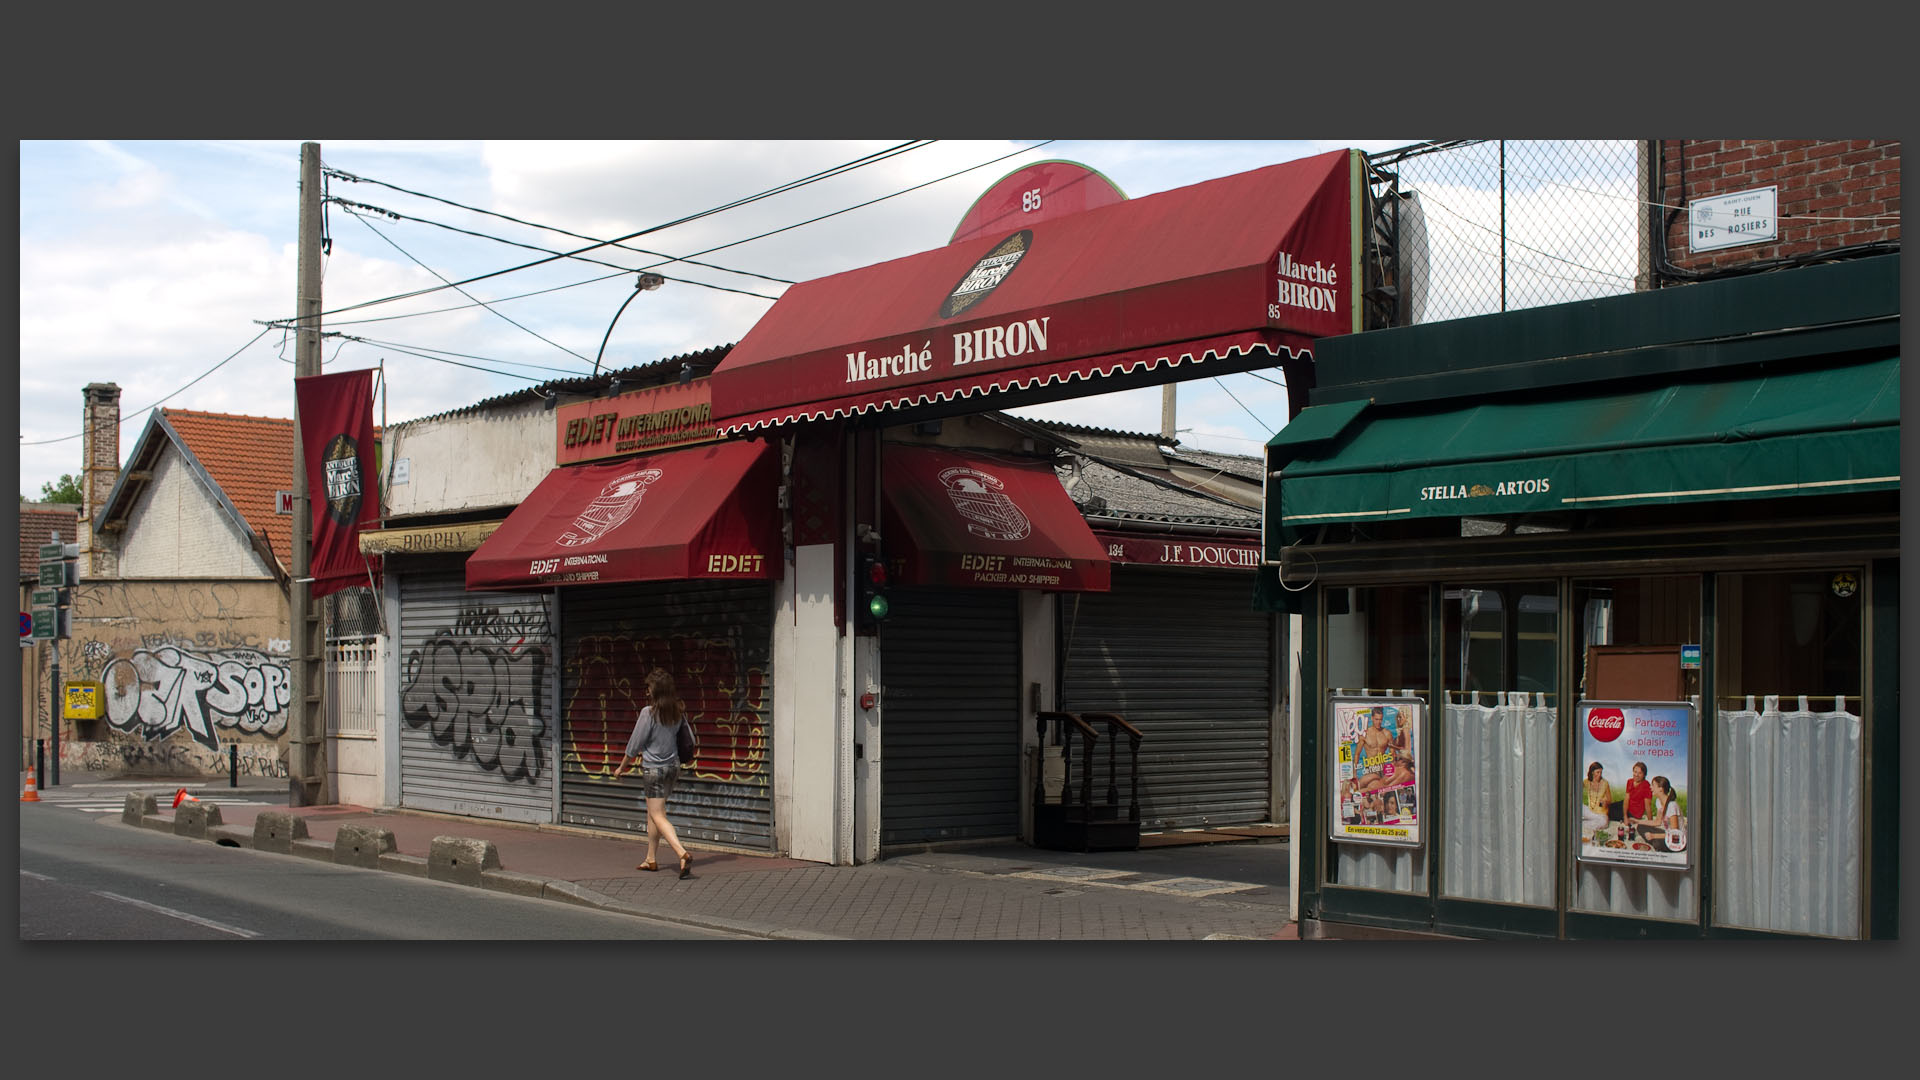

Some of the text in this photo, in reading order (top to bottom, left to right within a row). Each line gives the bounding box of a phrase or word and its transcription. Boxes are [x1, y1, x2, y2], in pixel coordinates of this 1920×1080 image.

[1022, 188, 1042, 213] 85
[1734, 207, 1752, 218] RUE
[1698, 229, 1715, 239] DES
[1728, 219, 1768, 235] ROSIERS
[1277, 251, 1338, 286] Marché
[954, 274, 1005, 294] BIRON
[1277, 279, 1338, 313] BIRON
[1268, 303, 1281, 320] 85
[845, 317, 1051, 383] Marché BIRON
[564, 402, 712, 448] EDET INTERNATIONA
[328, 480, 361, 498] BIRON
[1420, 478, 1550, 501] STELLA ARTOIS
[403, 531, 466, 550] BROPHY
[1108, 543, 1125, 557] 134
[1160, 544, 1185, 562] J.F.
[529, 554, 609, 575] EDET INTERNATIONAL
[707, 554, 766, 573] EDET
[961, 554, 1073, 572] EDET INTERNATIONAL
[575, 571, 599, 581] SHIPPER
[974, 572, 1060, 586] PACKER AND SHIPPER
[1634, 717, 1677, 729] Partagez
[1626, 737, 1665, 748] de plaisir
[1362, 751, 1394, 768] bodies
[1647, 748, 1674, 758] repas
